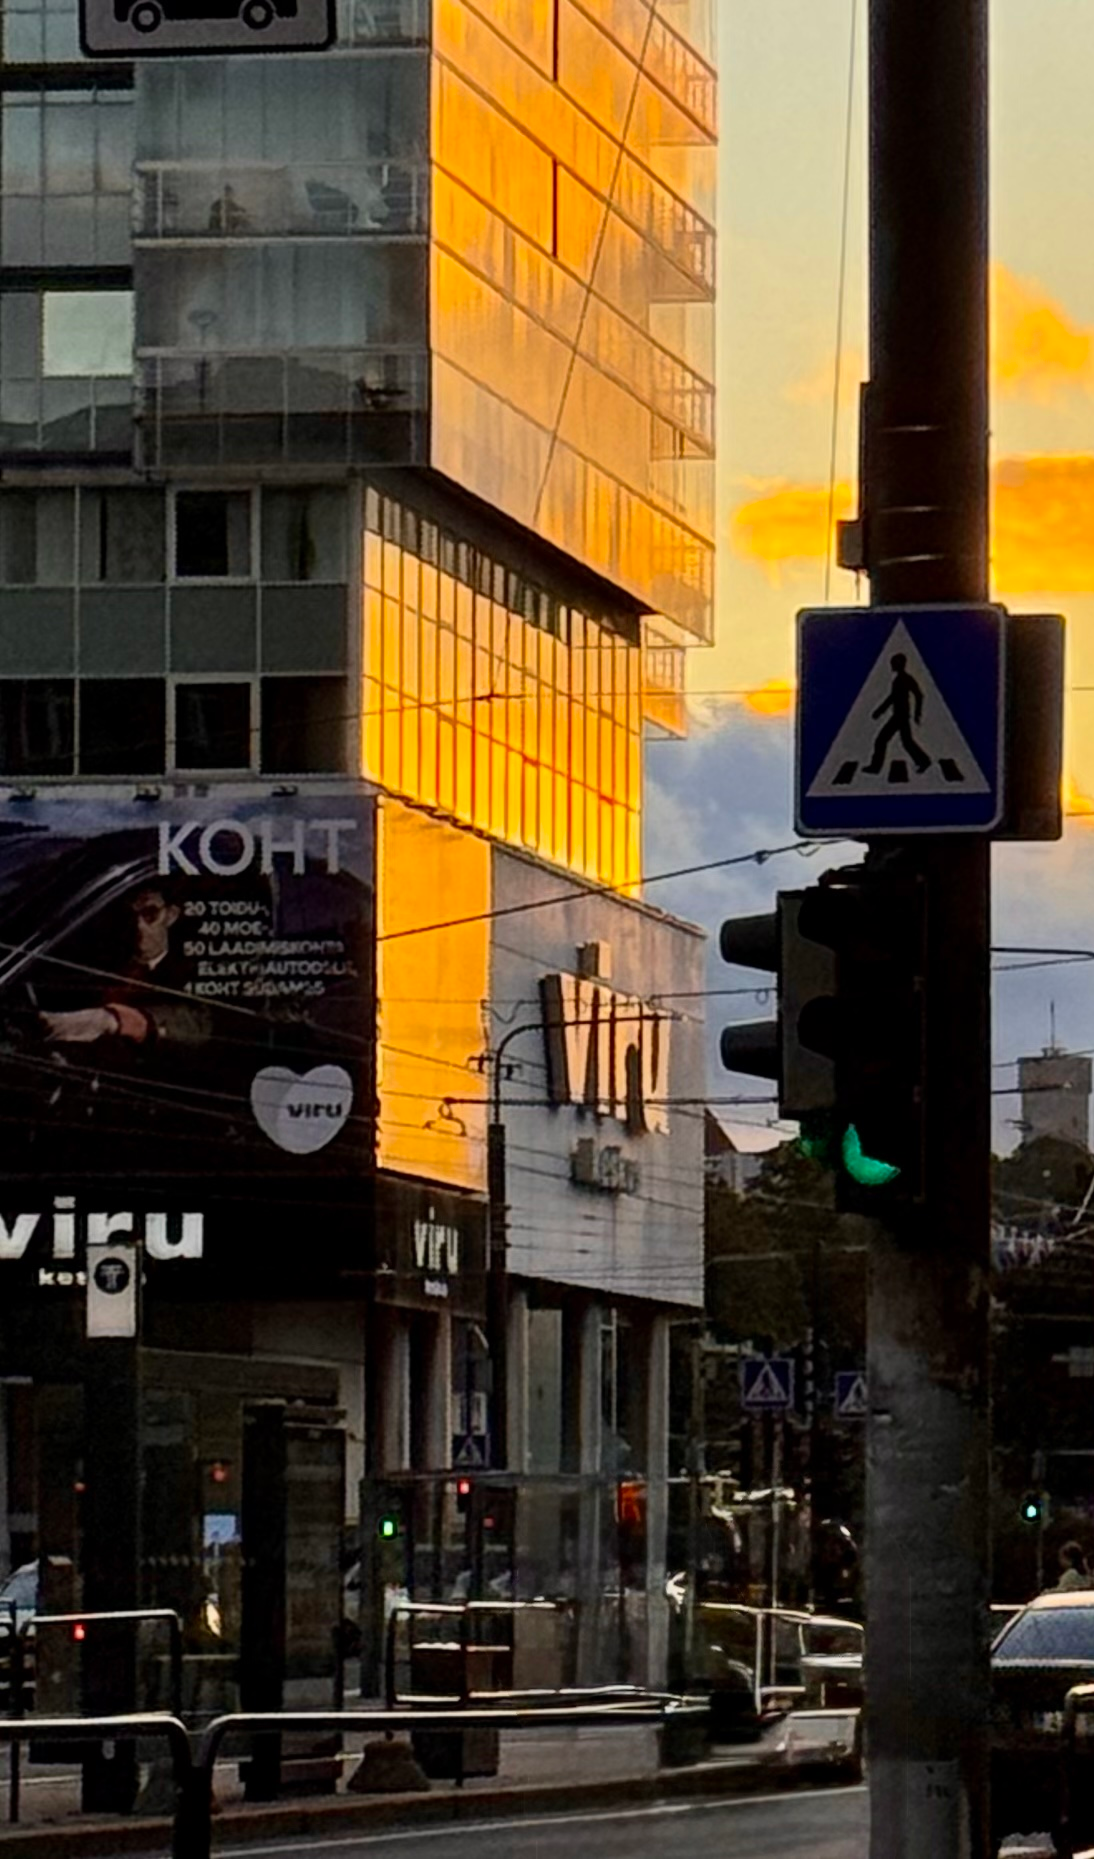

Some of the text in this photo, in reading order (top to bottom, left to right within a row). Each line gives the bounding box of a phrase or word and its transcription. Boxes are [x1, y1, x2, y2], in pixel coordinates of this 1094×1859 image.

[158, 818, 358, 877] KOHT
[184, 901, 206, 916] 20
[198, 921, 221, 936] 40
[183, 942, 206, 956] 50
[195, 980, 240, 996] KOHT
[539, 940, 672, 1136] viru
[287, 1103, 342, 1118] viru
[0, 1195, 204, 1261] viru
[414, 1206, 459, 1275] viru
